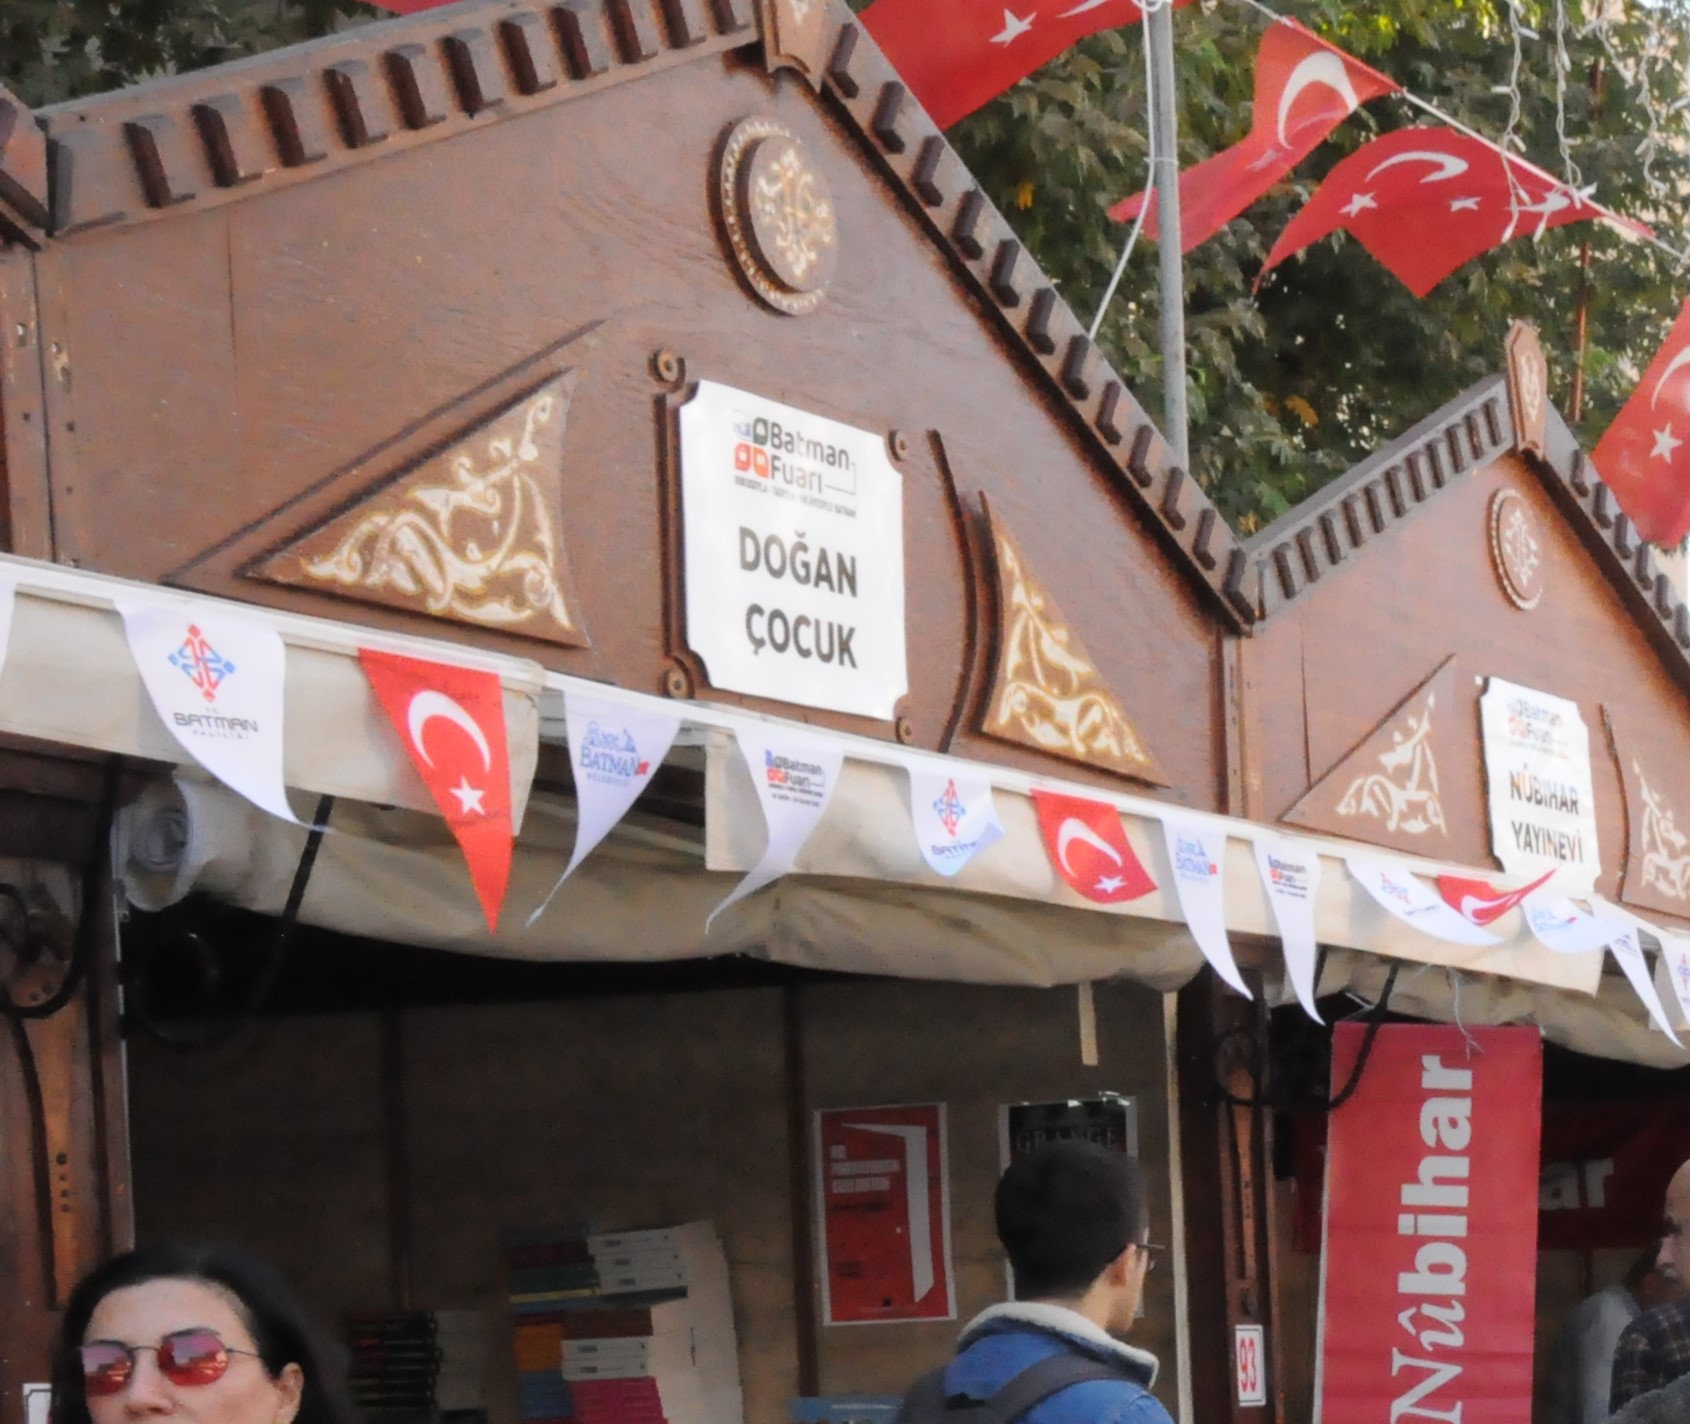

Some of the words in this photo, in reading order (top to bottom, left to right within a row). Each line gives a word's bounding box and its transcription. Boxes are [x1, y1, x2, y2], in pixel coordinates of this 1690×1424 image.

[769, 421, 850, 472] Batman
[770, 453, 823, 494] Fuarı
[739, 525, 858, 598] DOĞAN
[745, 603, 858, 669] ÇOCUK
[173, 712, 259, 733] BATMAN
[580, 744, 639, 778] BATMAN
[1239, 1337, 1257, 1393] 93
